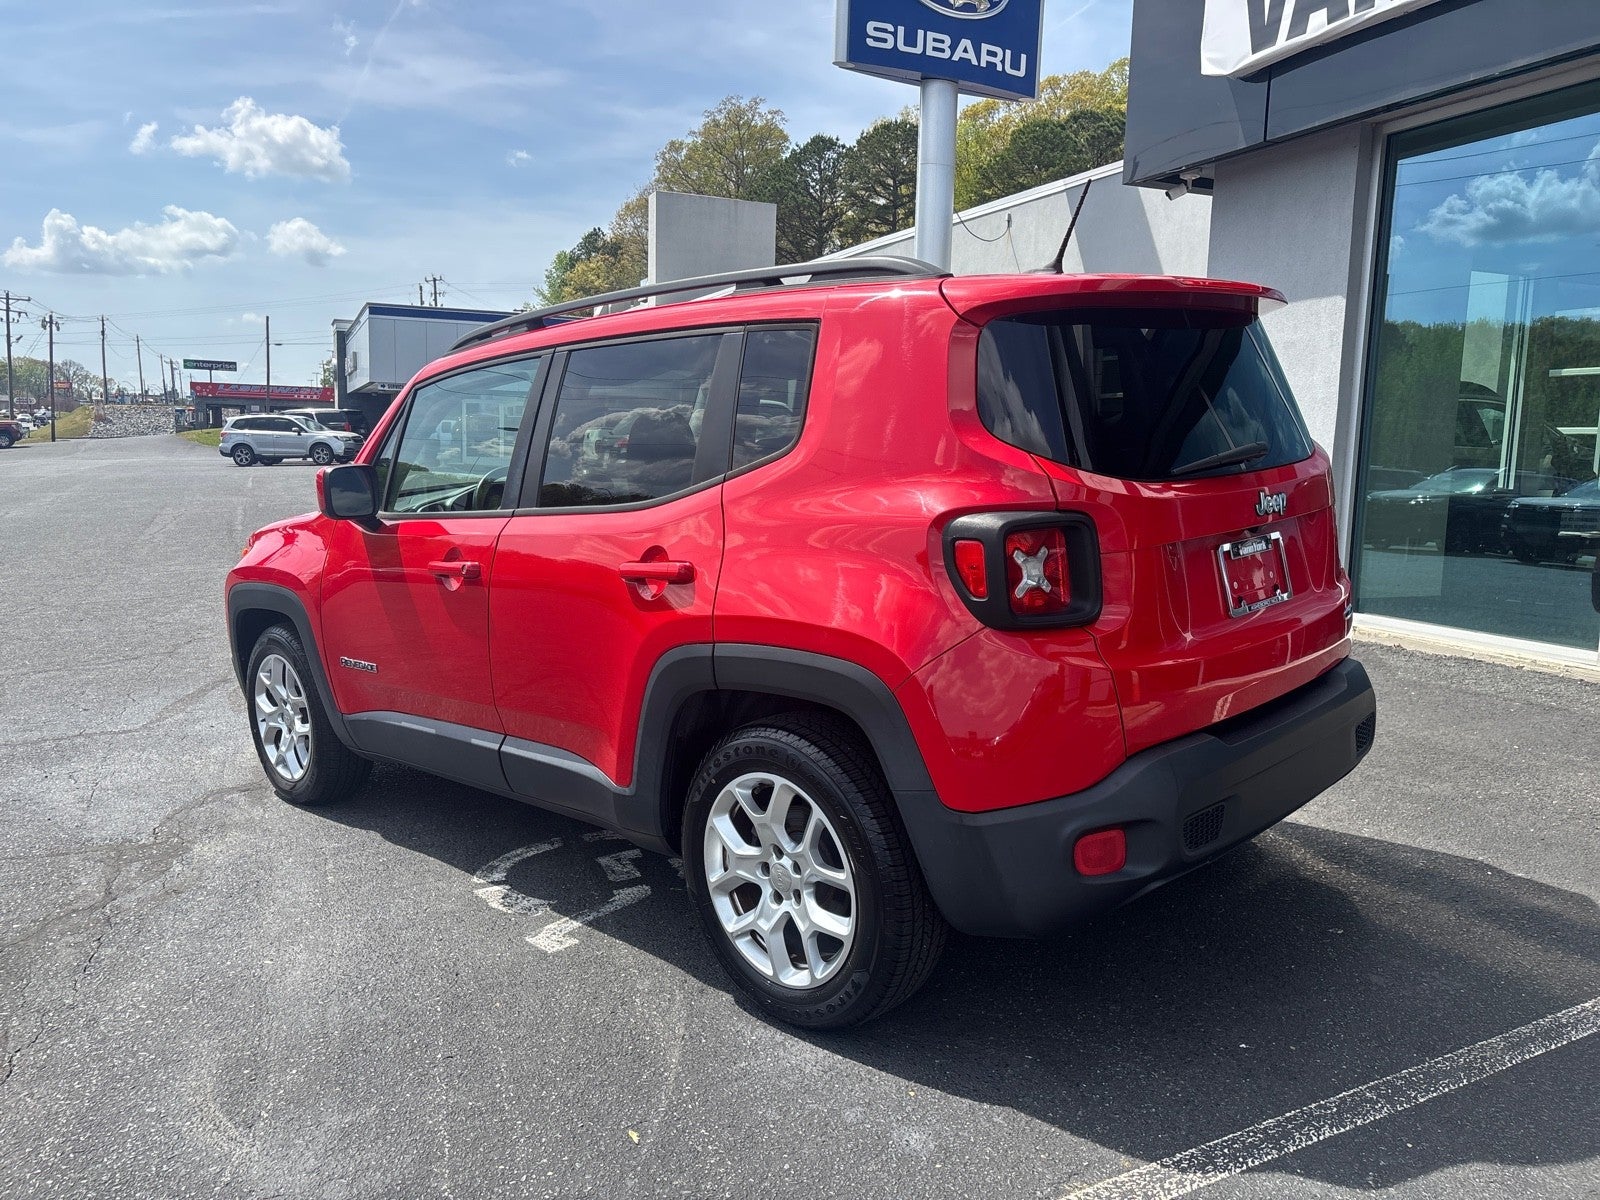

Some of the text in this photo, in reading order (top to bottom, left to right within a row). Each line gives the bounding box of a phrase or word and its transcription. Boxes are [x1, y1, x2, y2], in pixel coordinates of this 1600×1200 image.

[866, 20, 1027, 77] SUBARU
[185, 361, 236, 370] enterprise
[1256, 492, 1286, 516] Jeep
[340, 656, 377, 673] RENEGADE
